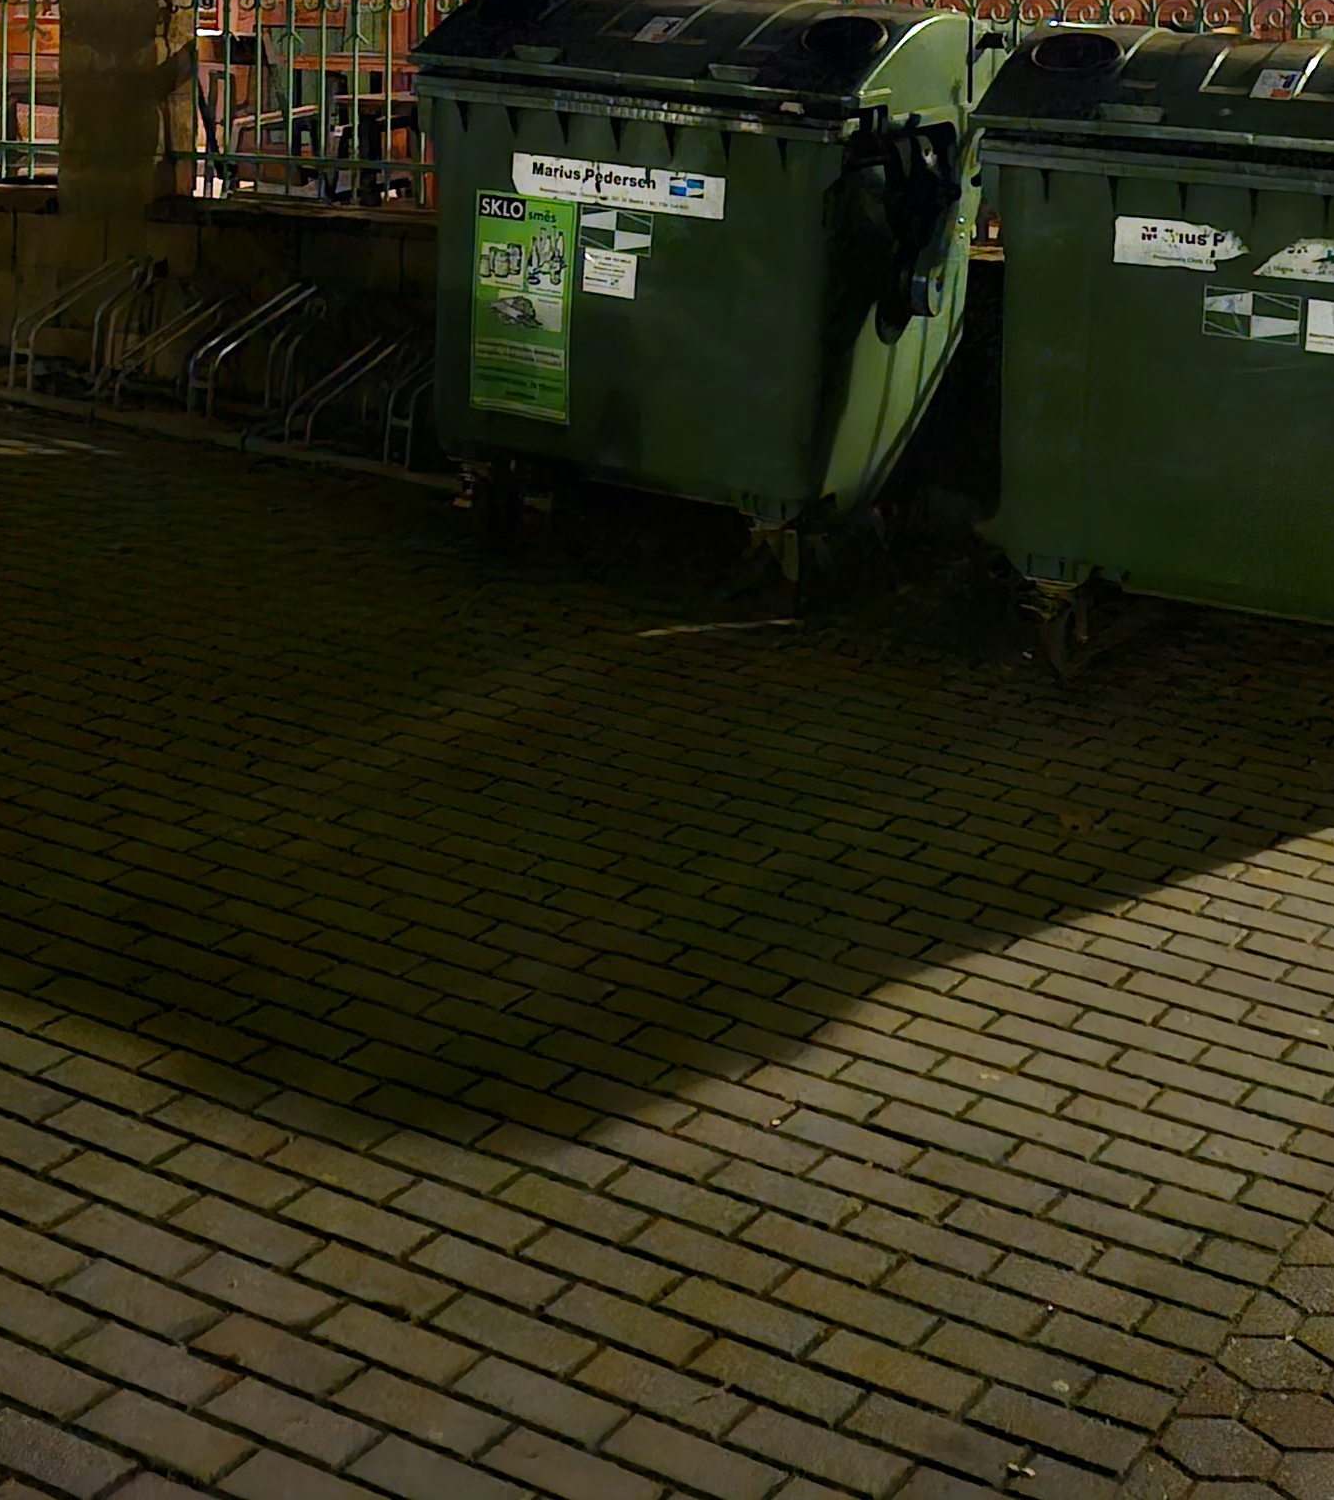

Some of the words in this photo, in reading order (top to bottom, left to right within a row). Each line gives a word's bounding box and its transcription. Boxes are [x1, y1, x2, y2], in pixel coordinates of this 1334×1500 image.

[532, 162, 581, 181] Marius
[585, 168, 656, 189] Pedersen
[480, 197, 524, 218] SKLO
[528, 209, 558, 223] směs
